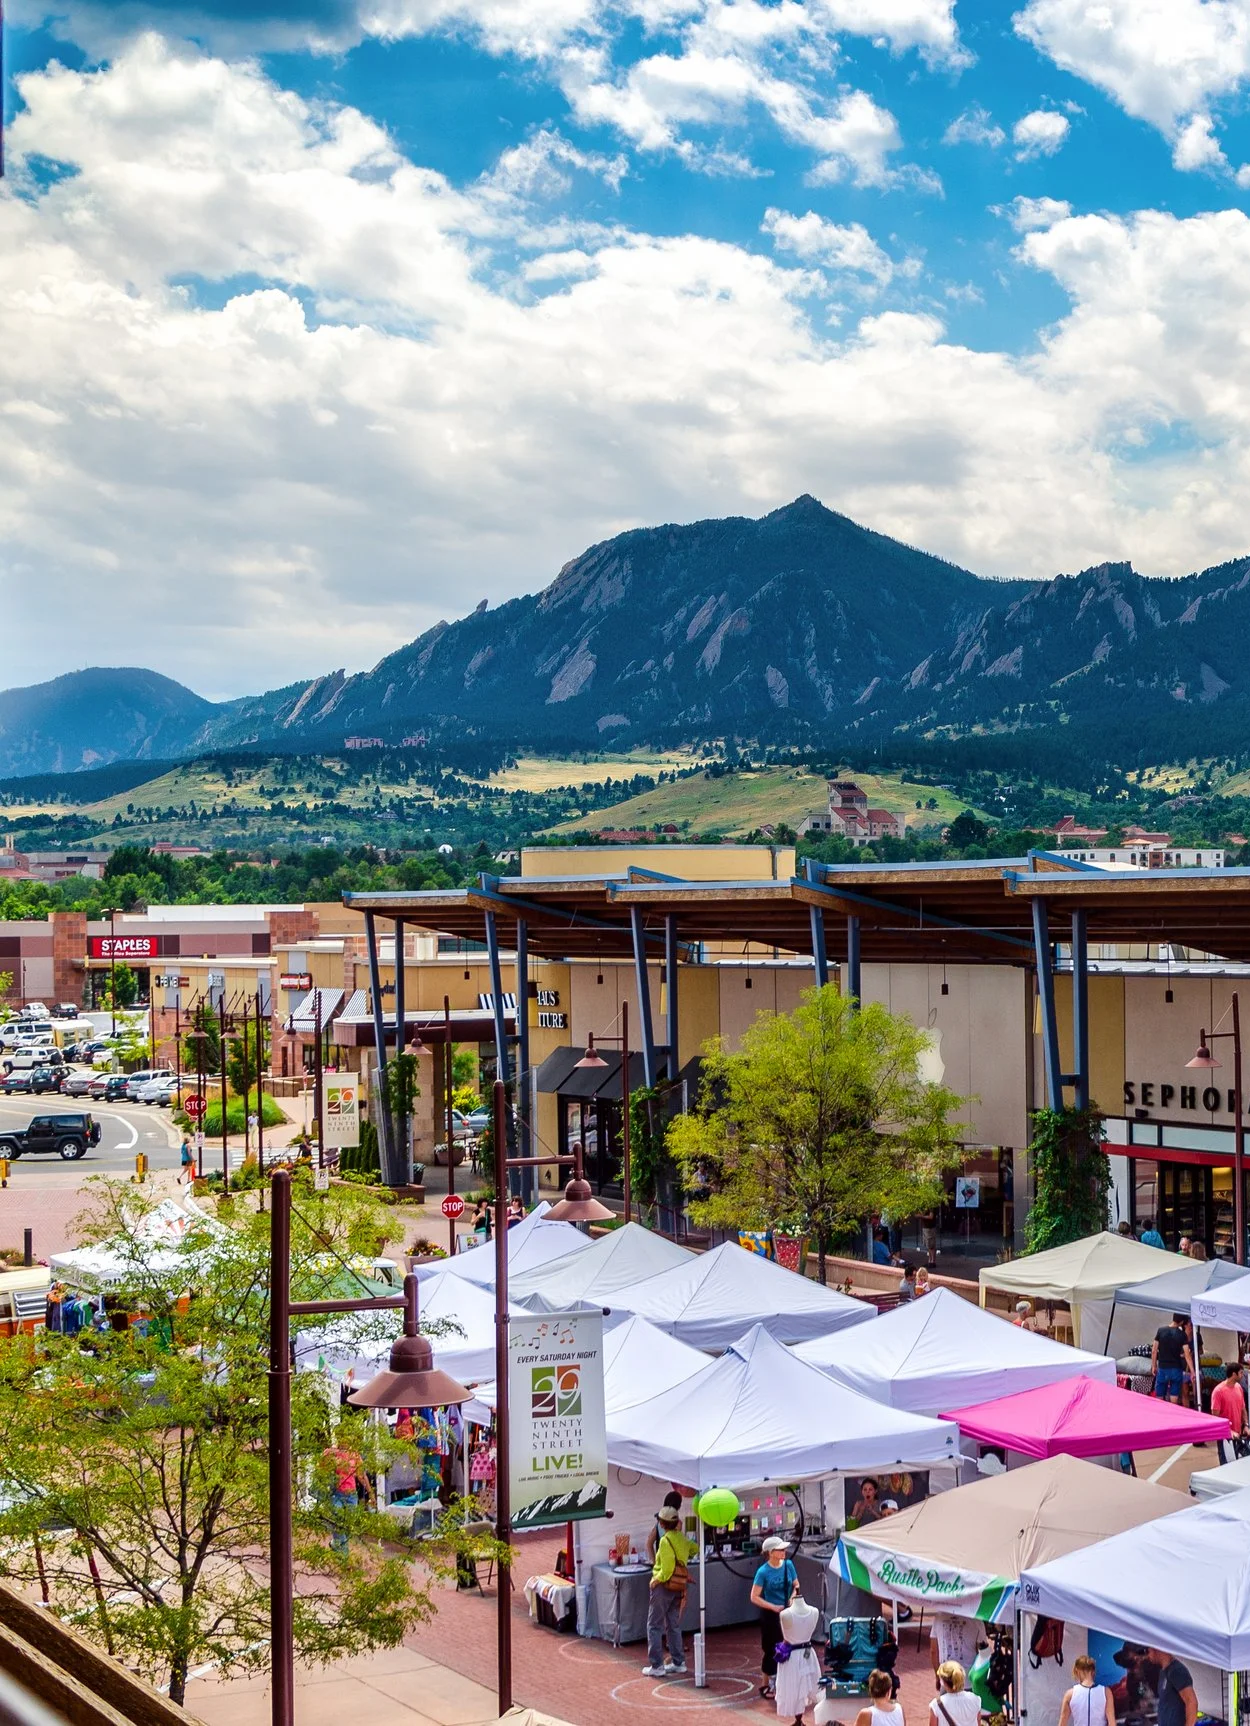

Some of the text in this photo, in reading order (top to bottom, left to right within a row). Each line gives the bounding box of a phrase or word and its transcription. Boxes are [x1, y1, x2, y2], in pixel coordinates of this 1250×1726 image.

[328, 1089, 354, 1115] 29
[442, 1202, 463, 1212] STOP
[517, 1350, 597, 1364] EVERY SATURDAY NIGHT
[532, 1368, 581, 1417] 29
[532, 1418, 583, 1430] TWENTY
[532, 1429, 582, 1440] NINTH
[532, 1439, 583, 1450] STREET
[532, 1453, 583, 1472] LIVE!
[877, 1560, 925, 1589] Bustle
